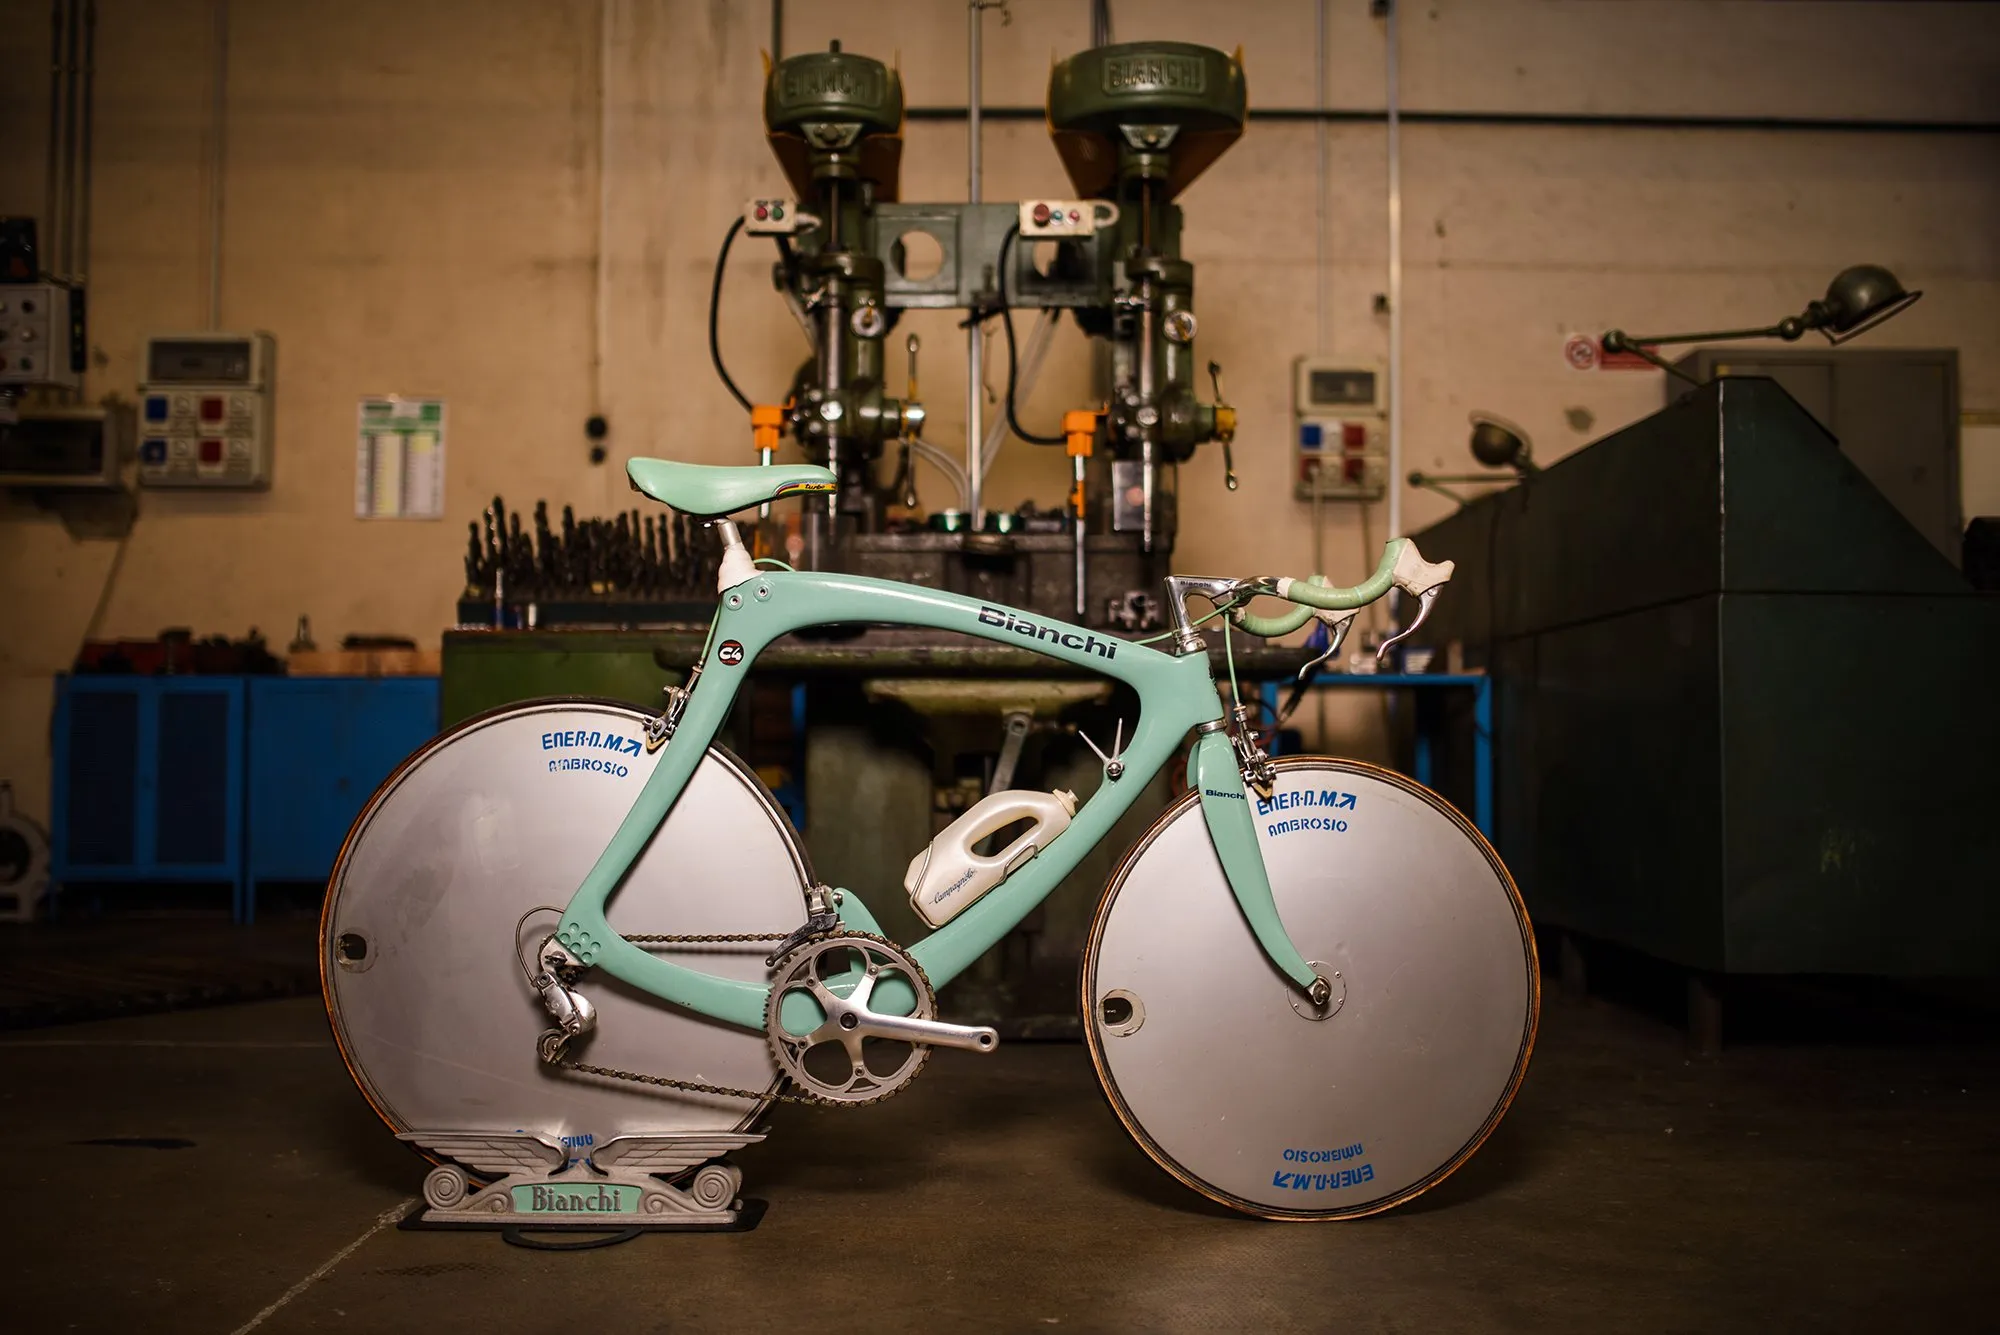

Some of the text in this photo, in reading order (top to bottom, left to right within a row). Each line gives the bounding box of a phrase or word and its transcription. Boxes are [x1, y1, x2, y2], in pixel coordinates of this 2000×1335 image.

[978, 606, 1117, 660] Bianchi
[719, 646, 742, 661] C4
[1205, 789, 1245, 800] Bianchi
[1268, 818, 1348, 837] AMBROSIO
[928, 868, 977, 904] Campagnolo
[1283, 1143, 1364, 1163] AMBROSIO
[532, 1185, 622, 1212] Bianchi
